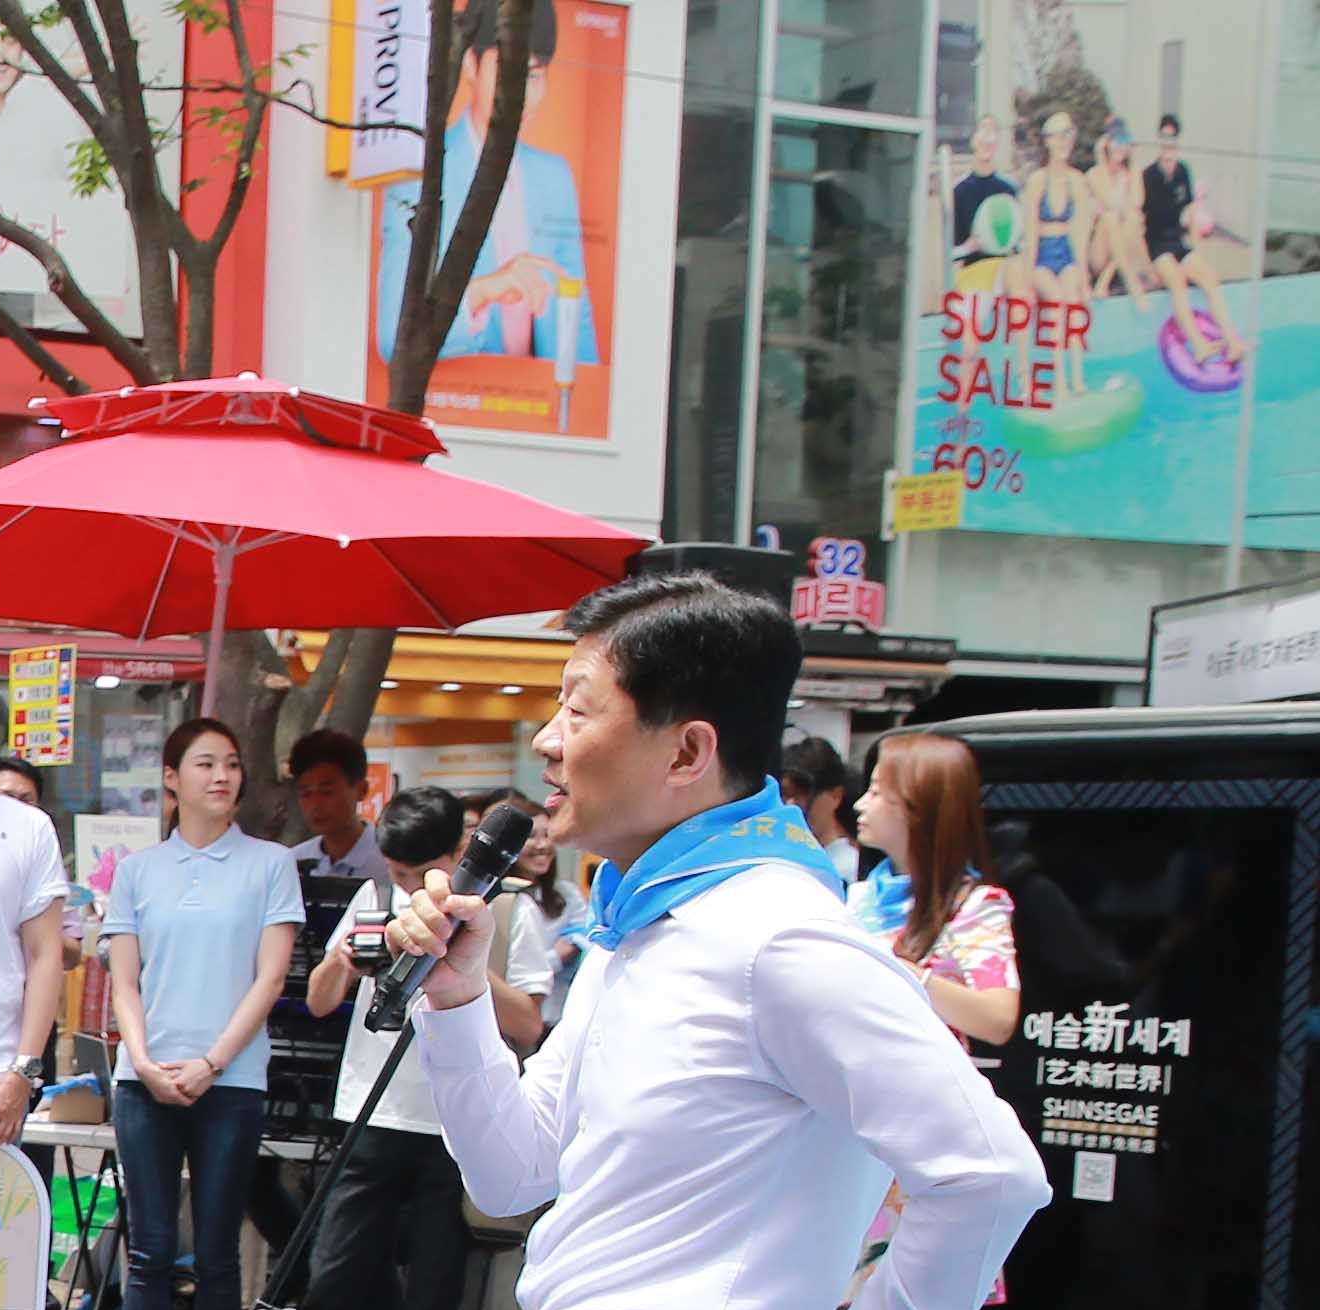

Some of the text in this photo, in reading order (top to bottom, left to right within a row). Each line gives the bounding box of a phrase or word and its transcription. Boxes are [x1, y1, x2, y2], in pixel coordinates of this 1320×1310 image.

[940, 290, 1092, 351] SUPER
[937, 353, 1056, 410] SALE
[821, 543, 861, 577] 32
[1023, 1000, 1192, 1057] 예술新세계
[1042, 1096, 1160, 1127] SHINSEGAE
